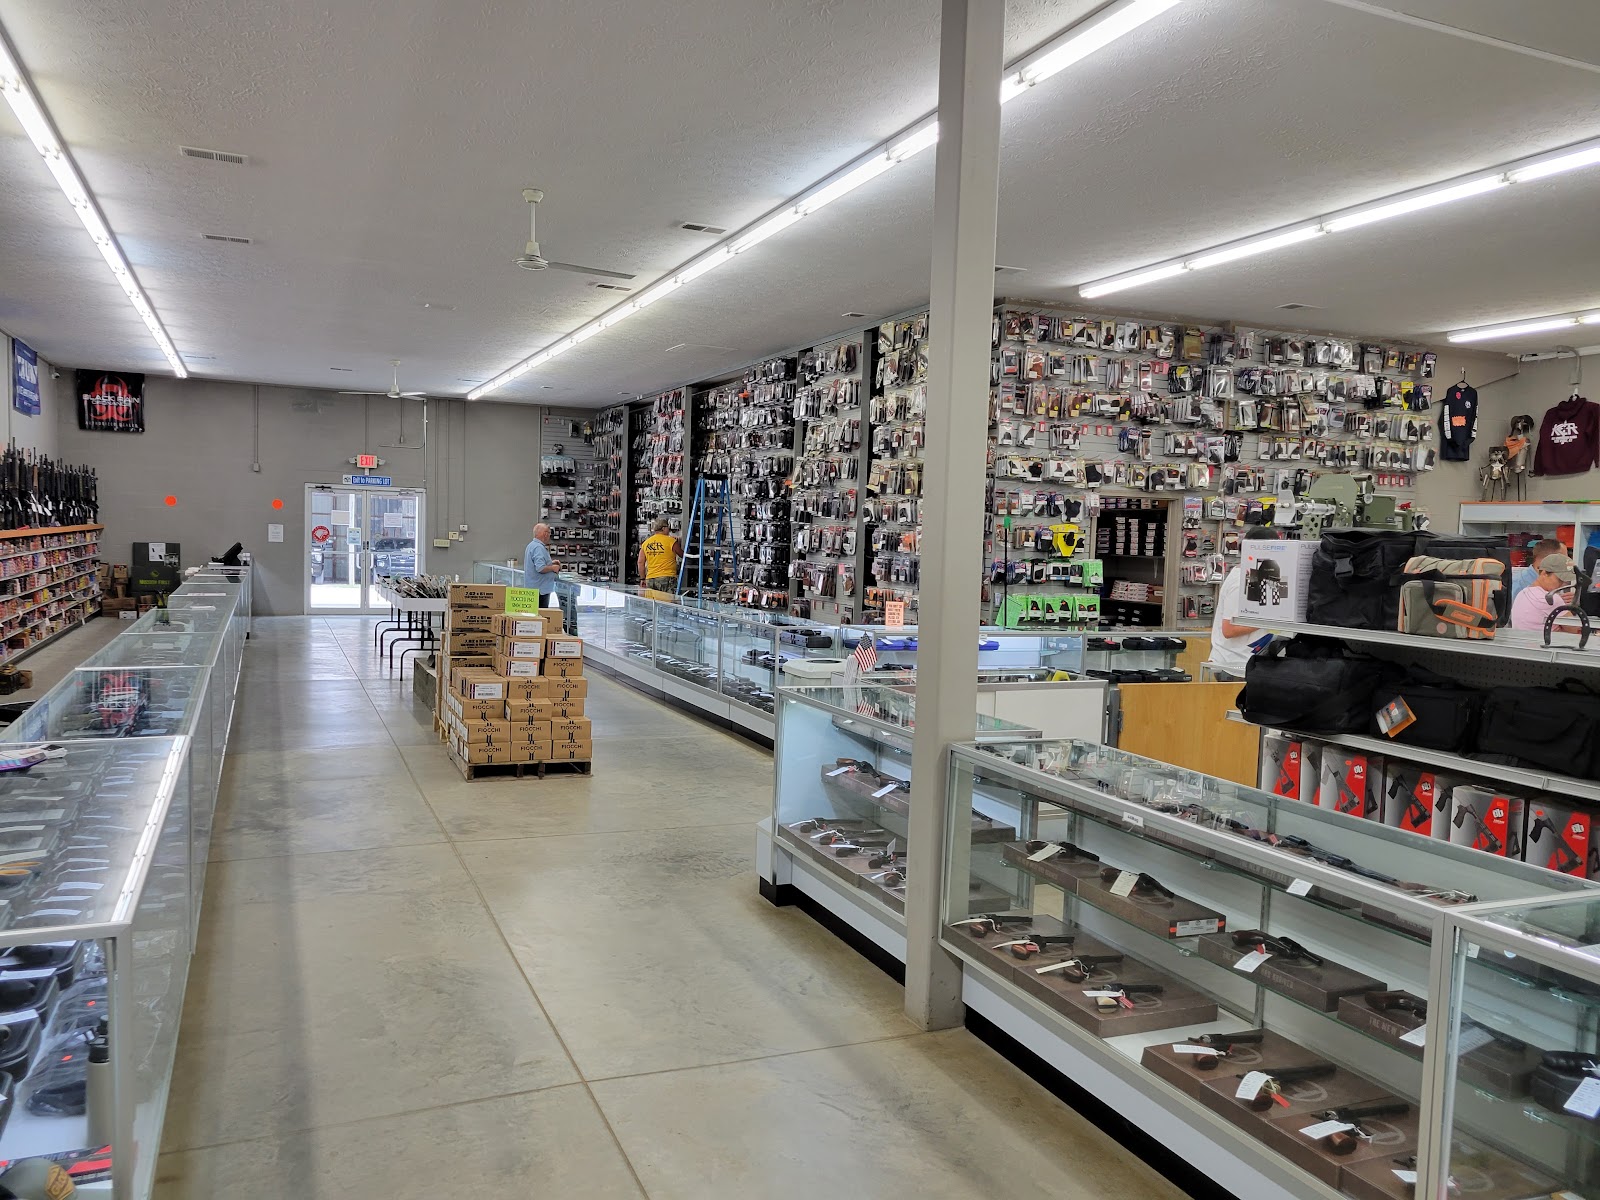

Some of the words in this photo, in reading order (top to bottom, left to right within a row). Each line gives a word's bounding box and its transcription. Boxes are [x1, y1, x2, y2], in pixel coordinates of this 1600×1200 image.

[82, 394, 115, 402] BLACK
[360, 456, 374, 466] EXIT
[1369, 1016, 1379, 1028] THE
[1381, 1022, 1398, 1036] NEW
